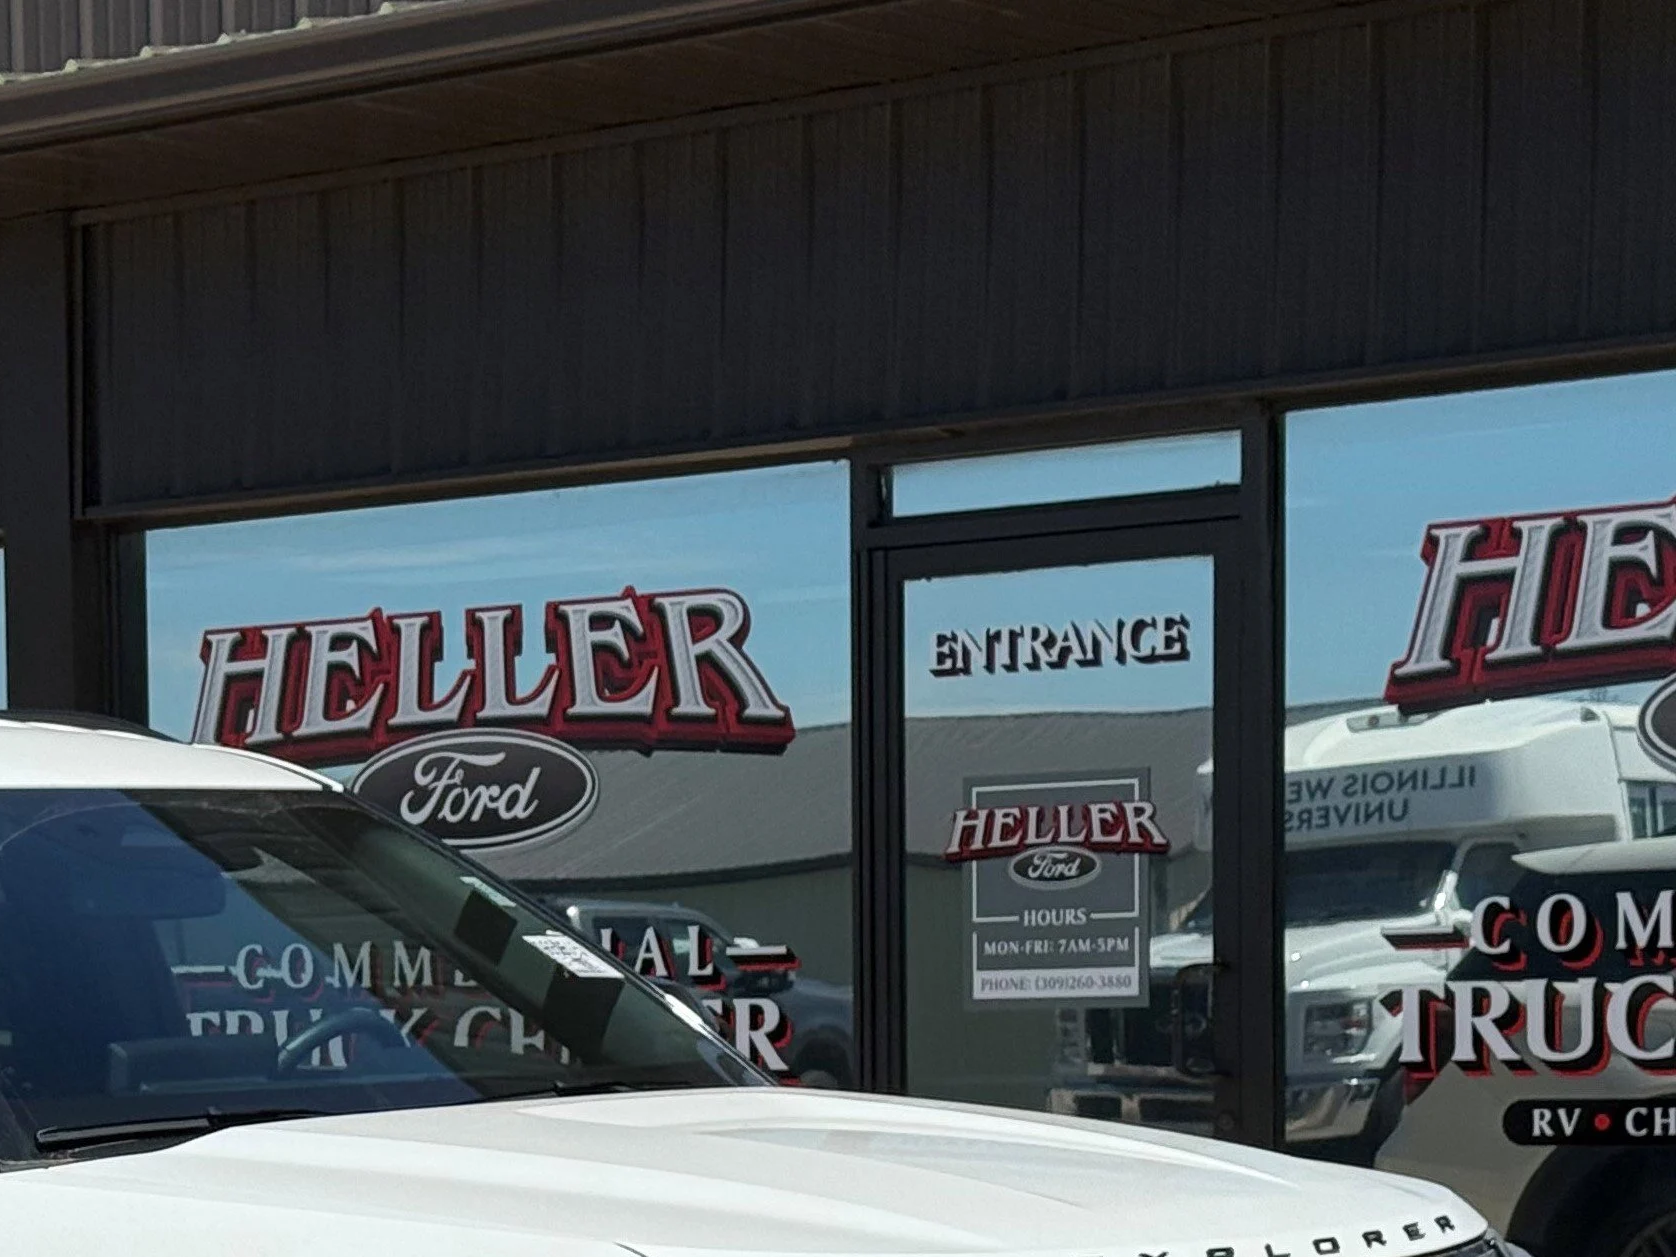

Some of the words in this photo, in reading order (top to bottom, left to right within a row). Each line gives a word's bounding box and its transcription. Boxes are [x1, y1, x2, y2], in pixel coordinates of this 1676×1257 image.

[929, 613, 1191, 677] ENTRANCE
[192, 588, 794, 756] HELLER
[400, 750, 541, 824] Ford
[943, 800, 1171, 860] HELLER
[1027, 851, 1080, 879] Ford
[1023, 907, 1088, 927] HOURS
[980, 975, 1032, 992] PHONE:
[1531, 1106, 1582, 1137] RV
